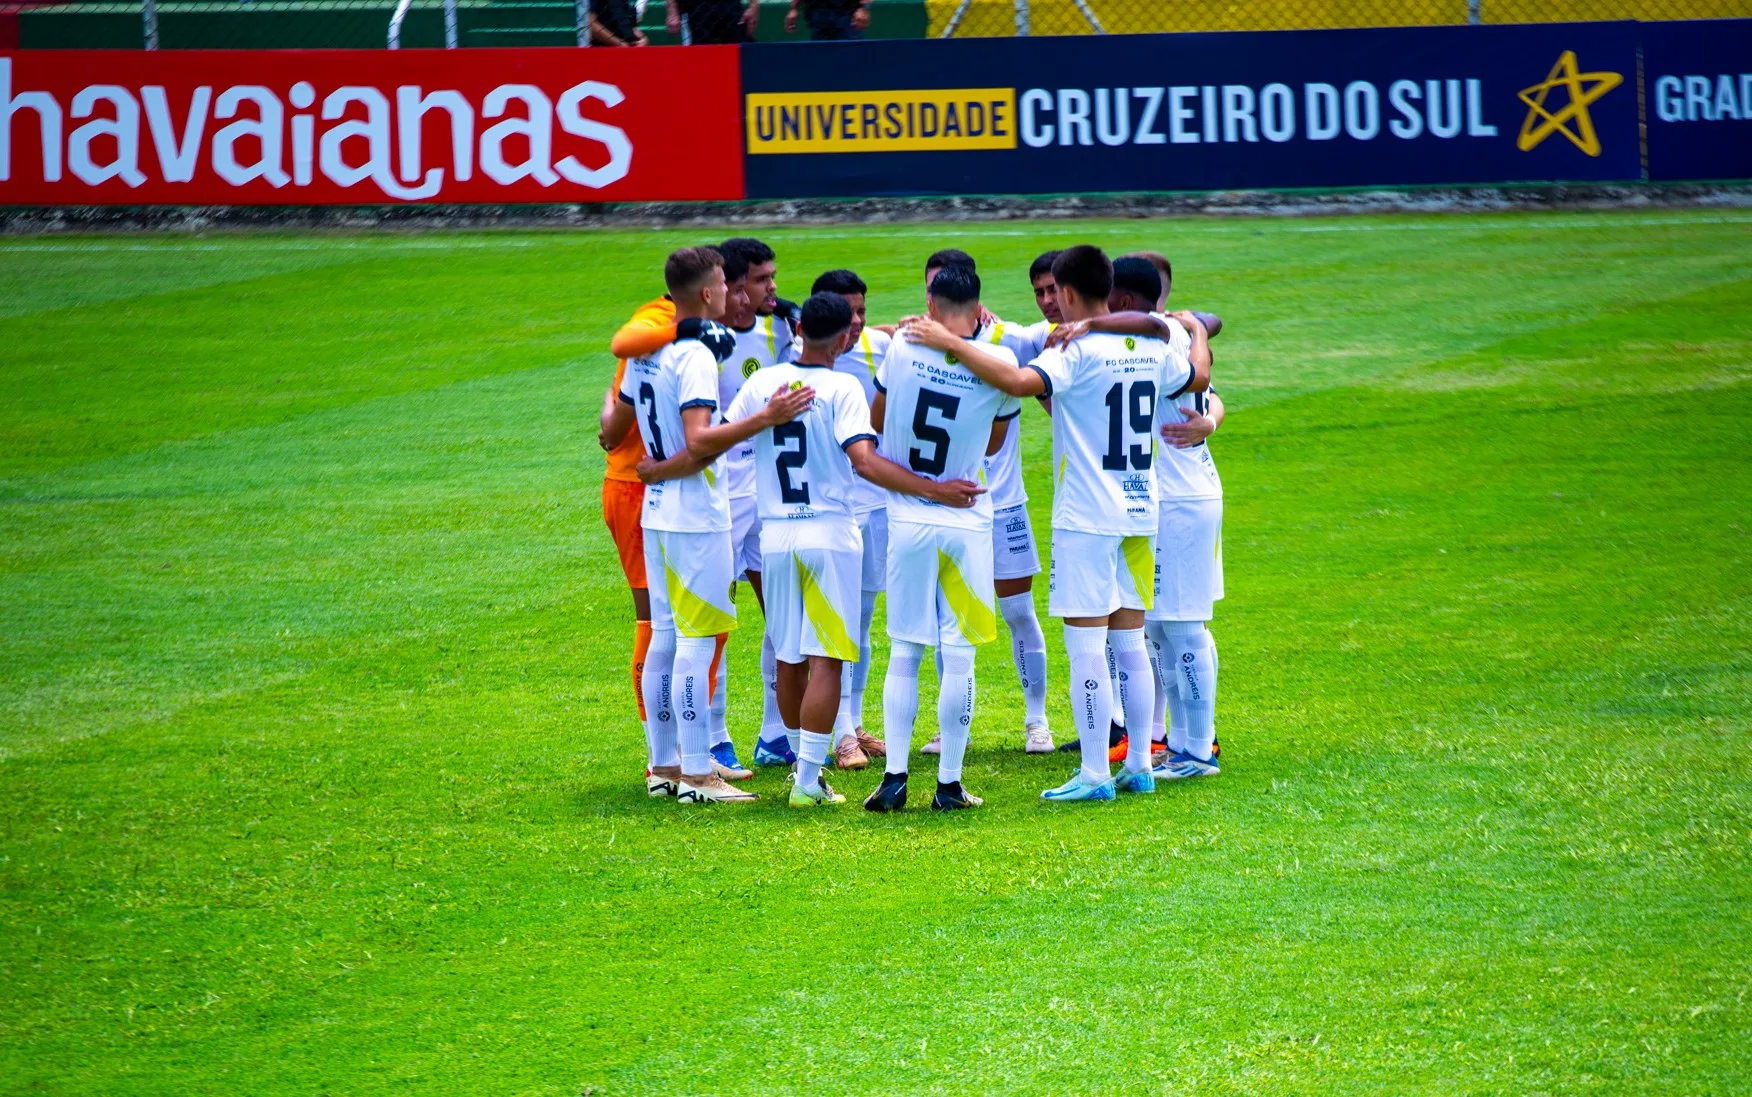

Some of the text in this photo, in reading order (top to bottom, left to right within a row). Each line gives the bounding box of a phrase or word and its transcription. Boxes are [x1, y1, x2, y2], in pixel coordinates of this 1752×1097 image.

[0, 57, 634, 200] havaianas
[754, 78, 1499, 147] UNIVERSIDADE CRUZEIRO DO SUL
[912, 360, 925, 370] FC
[926, 365, 983, 386] CASCAVEL
[1118, 357, 1159, 366] CASCAVEL
[639, 381, 667, 461] 3
[909, 387, 961, 477] 5
[1102, 380, 1156, 471] 19
[773, 421, 811, 506] 2
[1108, 647, 1117, 680] ANDREIS
[1184, 665, 1200, 700] ANDREIS
[686, 676, 694, 708] ANDREIS
[1085, 692, 1095, 730] ANDREIS
